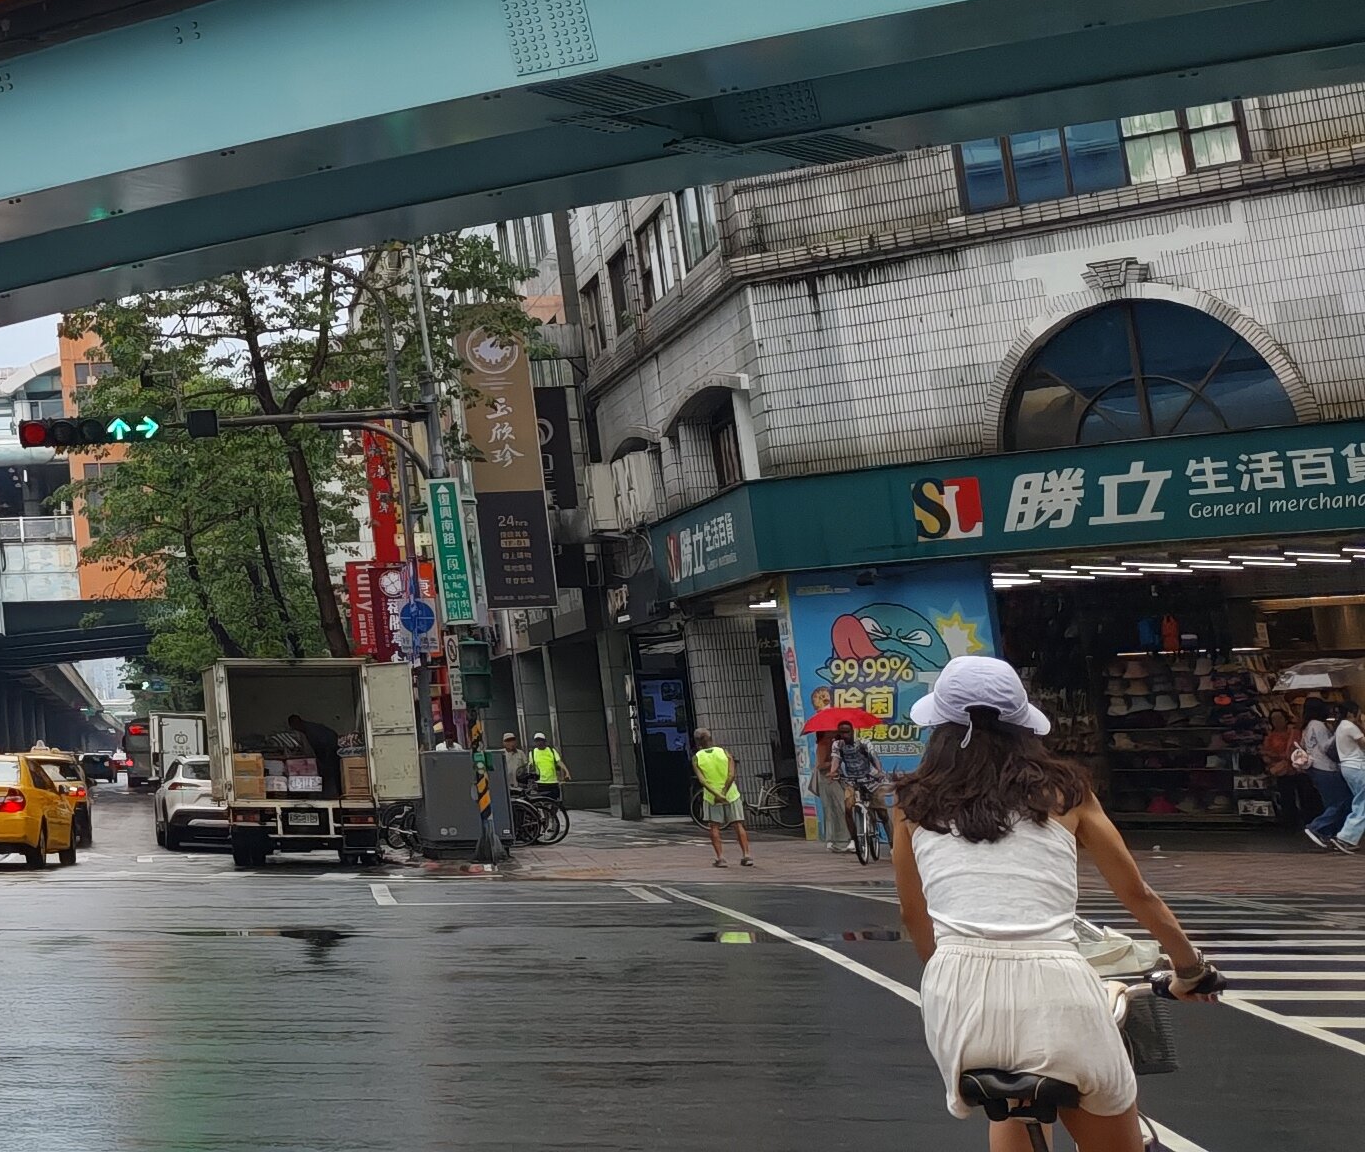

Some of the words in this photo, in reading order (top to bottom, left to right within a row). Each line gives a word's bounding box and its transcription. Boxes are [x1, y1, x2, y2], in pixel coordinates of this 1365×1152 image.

[1002, 460, 1173, 532] 勝立
[1188, 499, 1262, 519] General
[830, 657, 914, 684] 99.99%
